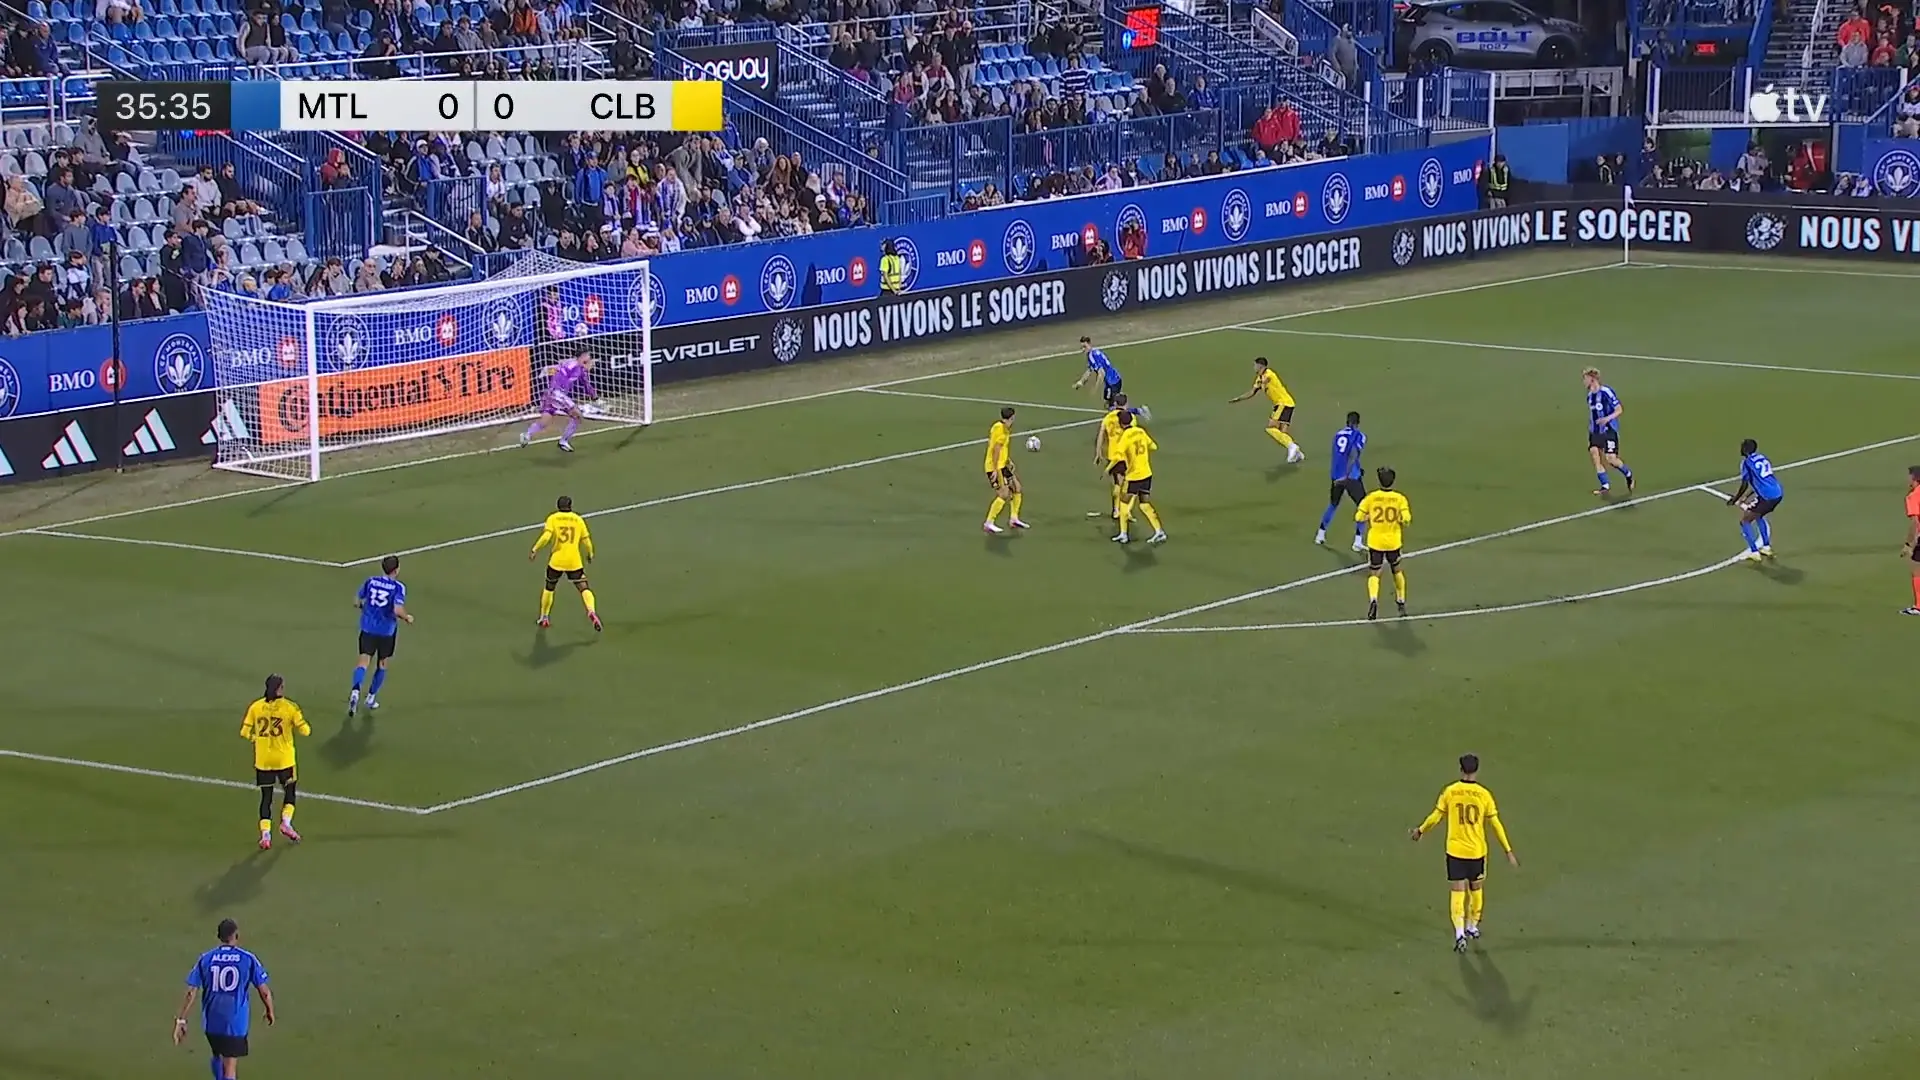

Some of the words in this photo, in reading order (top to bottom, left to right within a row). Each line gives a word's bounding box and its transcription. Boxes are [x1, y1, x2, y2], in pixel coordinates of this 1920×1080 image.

[1456, 30, 1533, 43] BOLT
[1453, 168, 1472, 185] BMO
[1364, 183, 1389, 200] BMO
[1265, 200, 1291, 218] BMO
[1162, 215, 1188, 234] BMO
[1423, 220, 1467, 258] NOUS
[1472, 212, 1531, 251] VIVONS
[1535, 209, 1568, 241] LE
[1578, 208, 1692, 242] SOCCER
[1800, 215, 1881, 250] NOUS
[1051, 231, 1079, 250] BMO
[936, 248, 966, 267] BMO
[815, 266, 846, 286] BMO
[1137, 262, 1188, 302] NOUS
[1193, 250, 1261, 293] VIVONS
[1266, 247, 1286, 282] LE
[1291, 237, 1361, 278] SOCCER
[685, 285, 718, 305] BMO
[813, 308, 872, 352] NOUS
[877, 295, 955, 342] VIVONS
[961, 289, 983, 329] LE
[988, 279, 1066, 325] SOCCER
[395, 326, 432, 346] BMO
[231, 347, 271, 369] BMO
[610, 335, 760, 370] CHEVROLET
[50, 369, 95, 393] BMO
[458, 360, 514, 398] Tire
[1336, 436, 1349, 453] 9
[1373, 507, 1398, 523] 20
[559, 526, 576, 544] 31
[370, 587, 389, 607] 13
[257, 716, 284, 737] 23
[1456, 803, 1480, 825] 10
[211, 953, 241, 963] ALEXIS
[210, 965, 240, 992] 10
